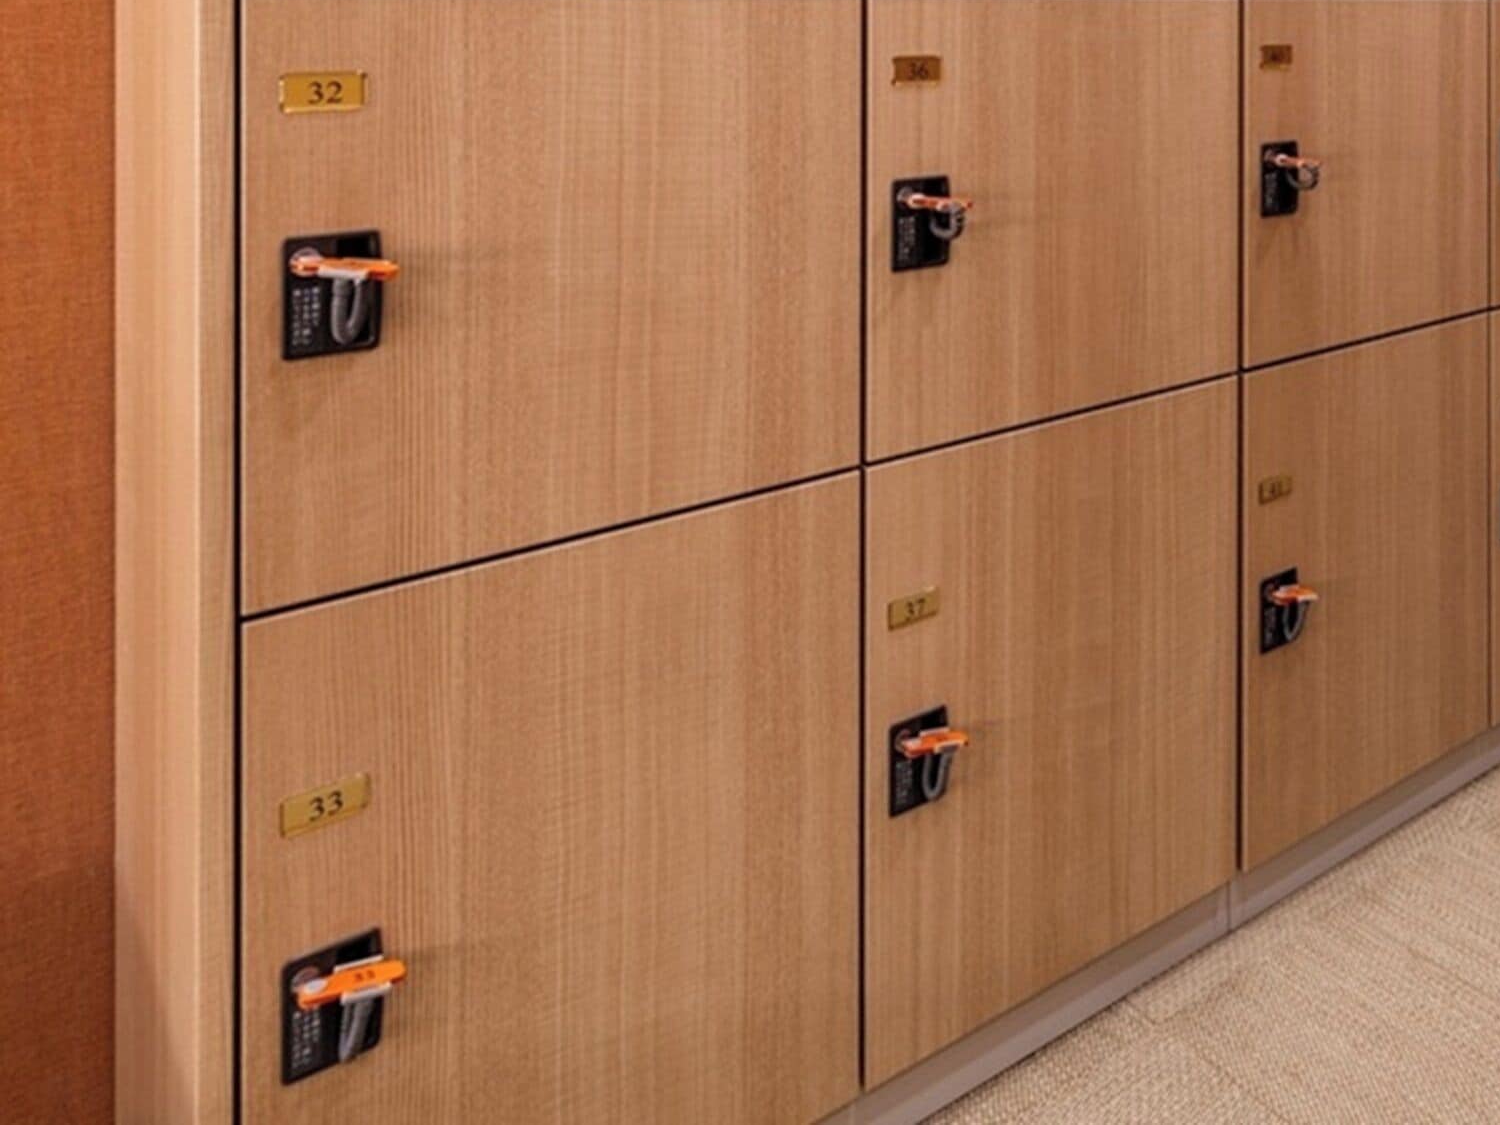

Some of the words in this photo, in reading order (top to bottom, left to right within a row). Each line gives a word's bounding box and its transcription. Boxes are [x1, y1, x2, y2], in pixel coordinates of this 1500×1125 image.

[307, 79, 343, 105] 32
[905, 598, 926, 619] 37
[308, 791, 344, 822] 33
